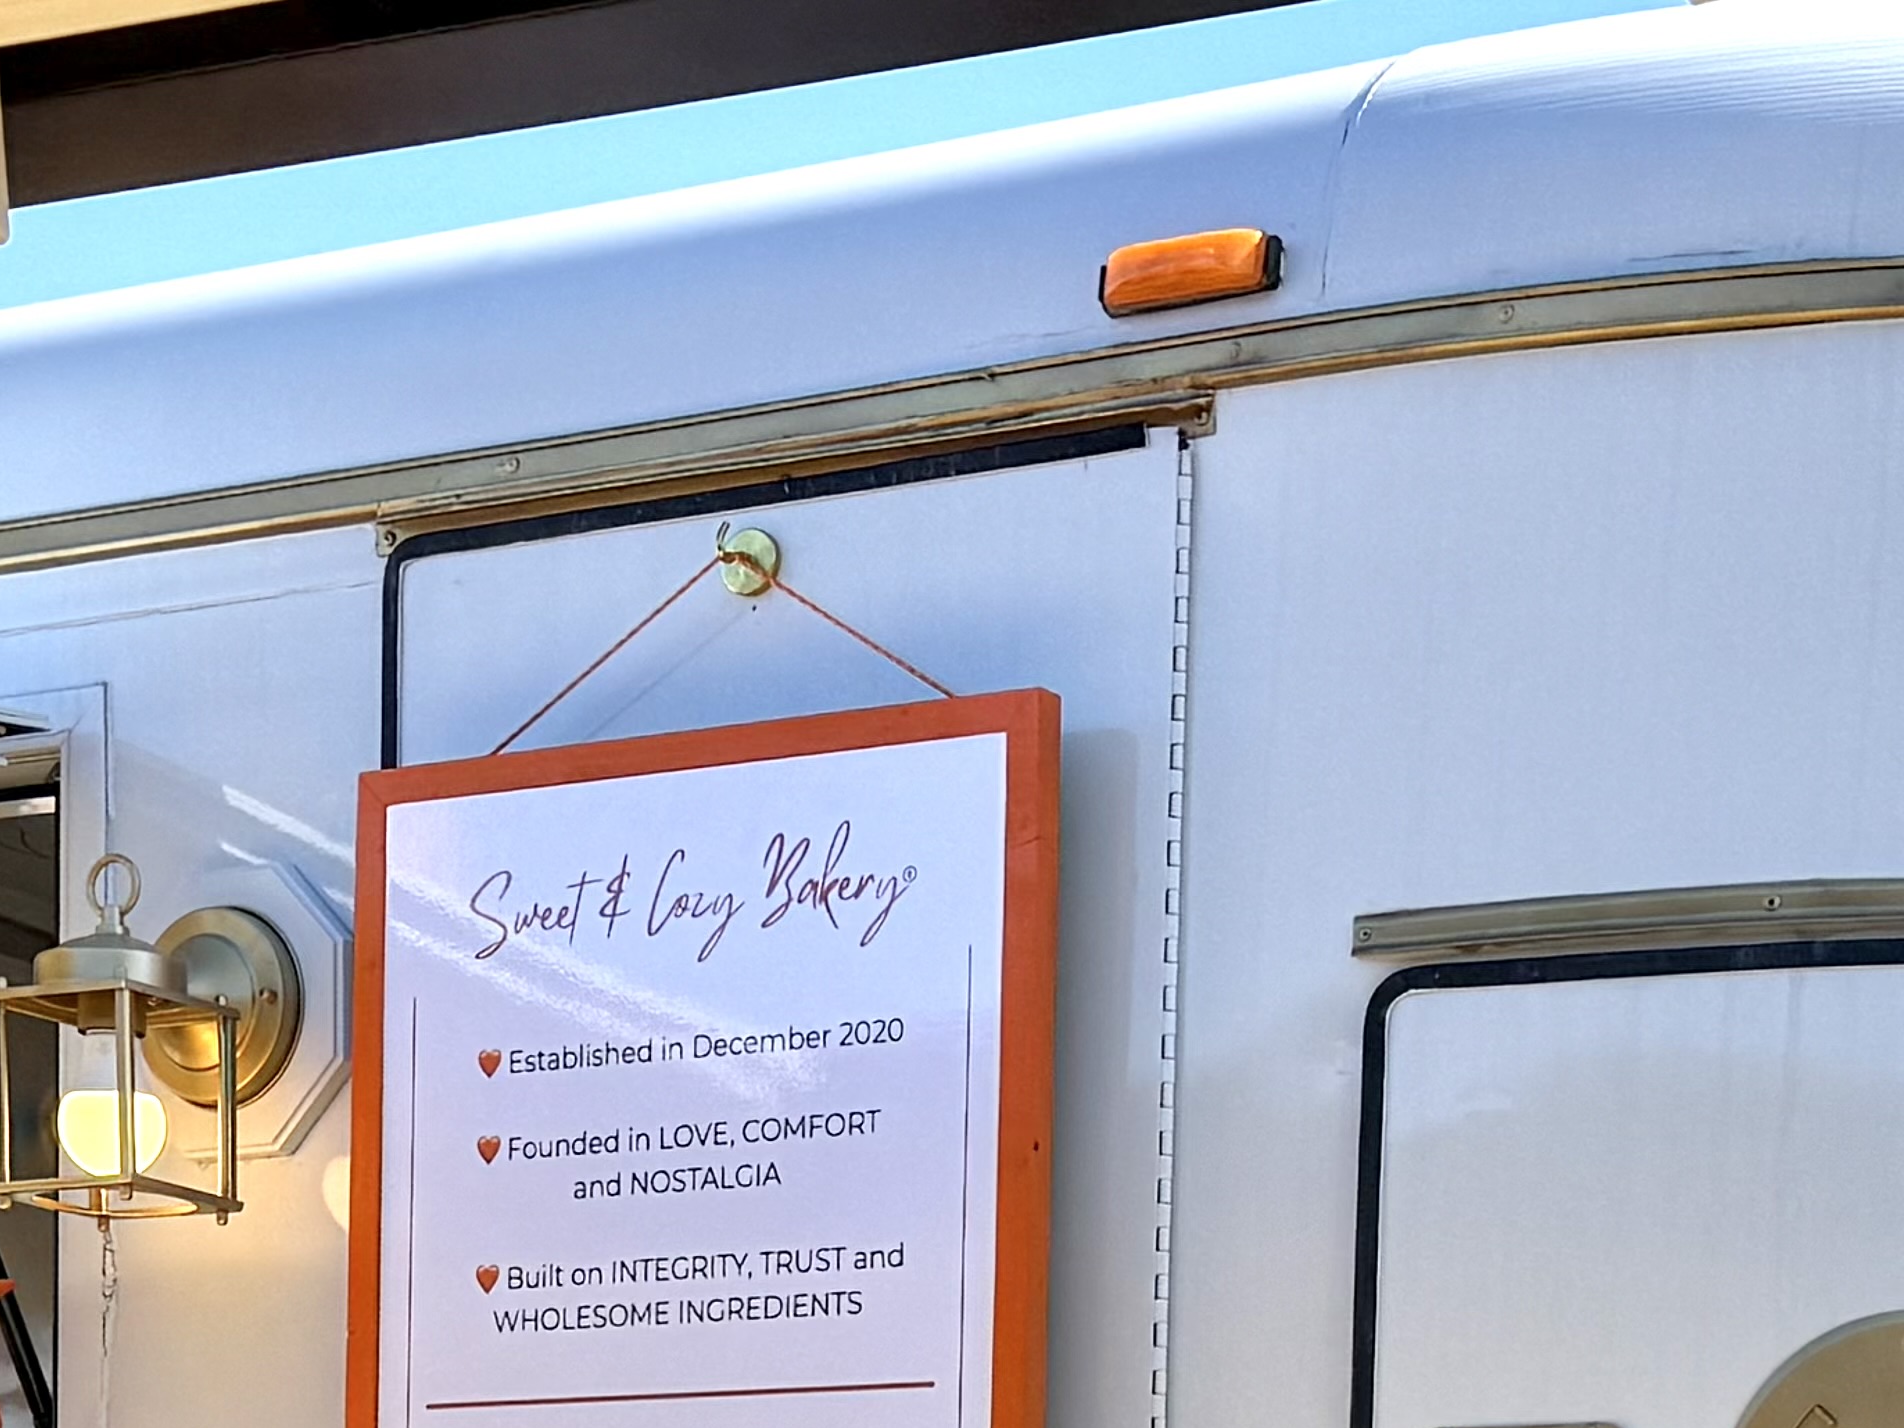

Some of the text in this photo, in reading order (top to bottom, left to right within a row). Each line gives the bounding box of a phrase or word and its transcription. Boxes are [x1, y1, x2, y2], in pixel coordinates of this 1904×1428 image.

[470, 870, 605, 960] Sweet
[599, 854, 631, 939] &
[647, 849, 746, 963] Cozy
[508, 1018, 904, 1075] Established in December 2020
[507, 1110, 882, 1162] Founded in LOVE, COMFORT
[572, 1162, 782, 1201] and NOSTALGIA
[507, 1242, 905, 1291] Built on INTEGRITY, TRUST and
[492, 1290, 863, 1335] WHOLESOME INGREDIENTS
